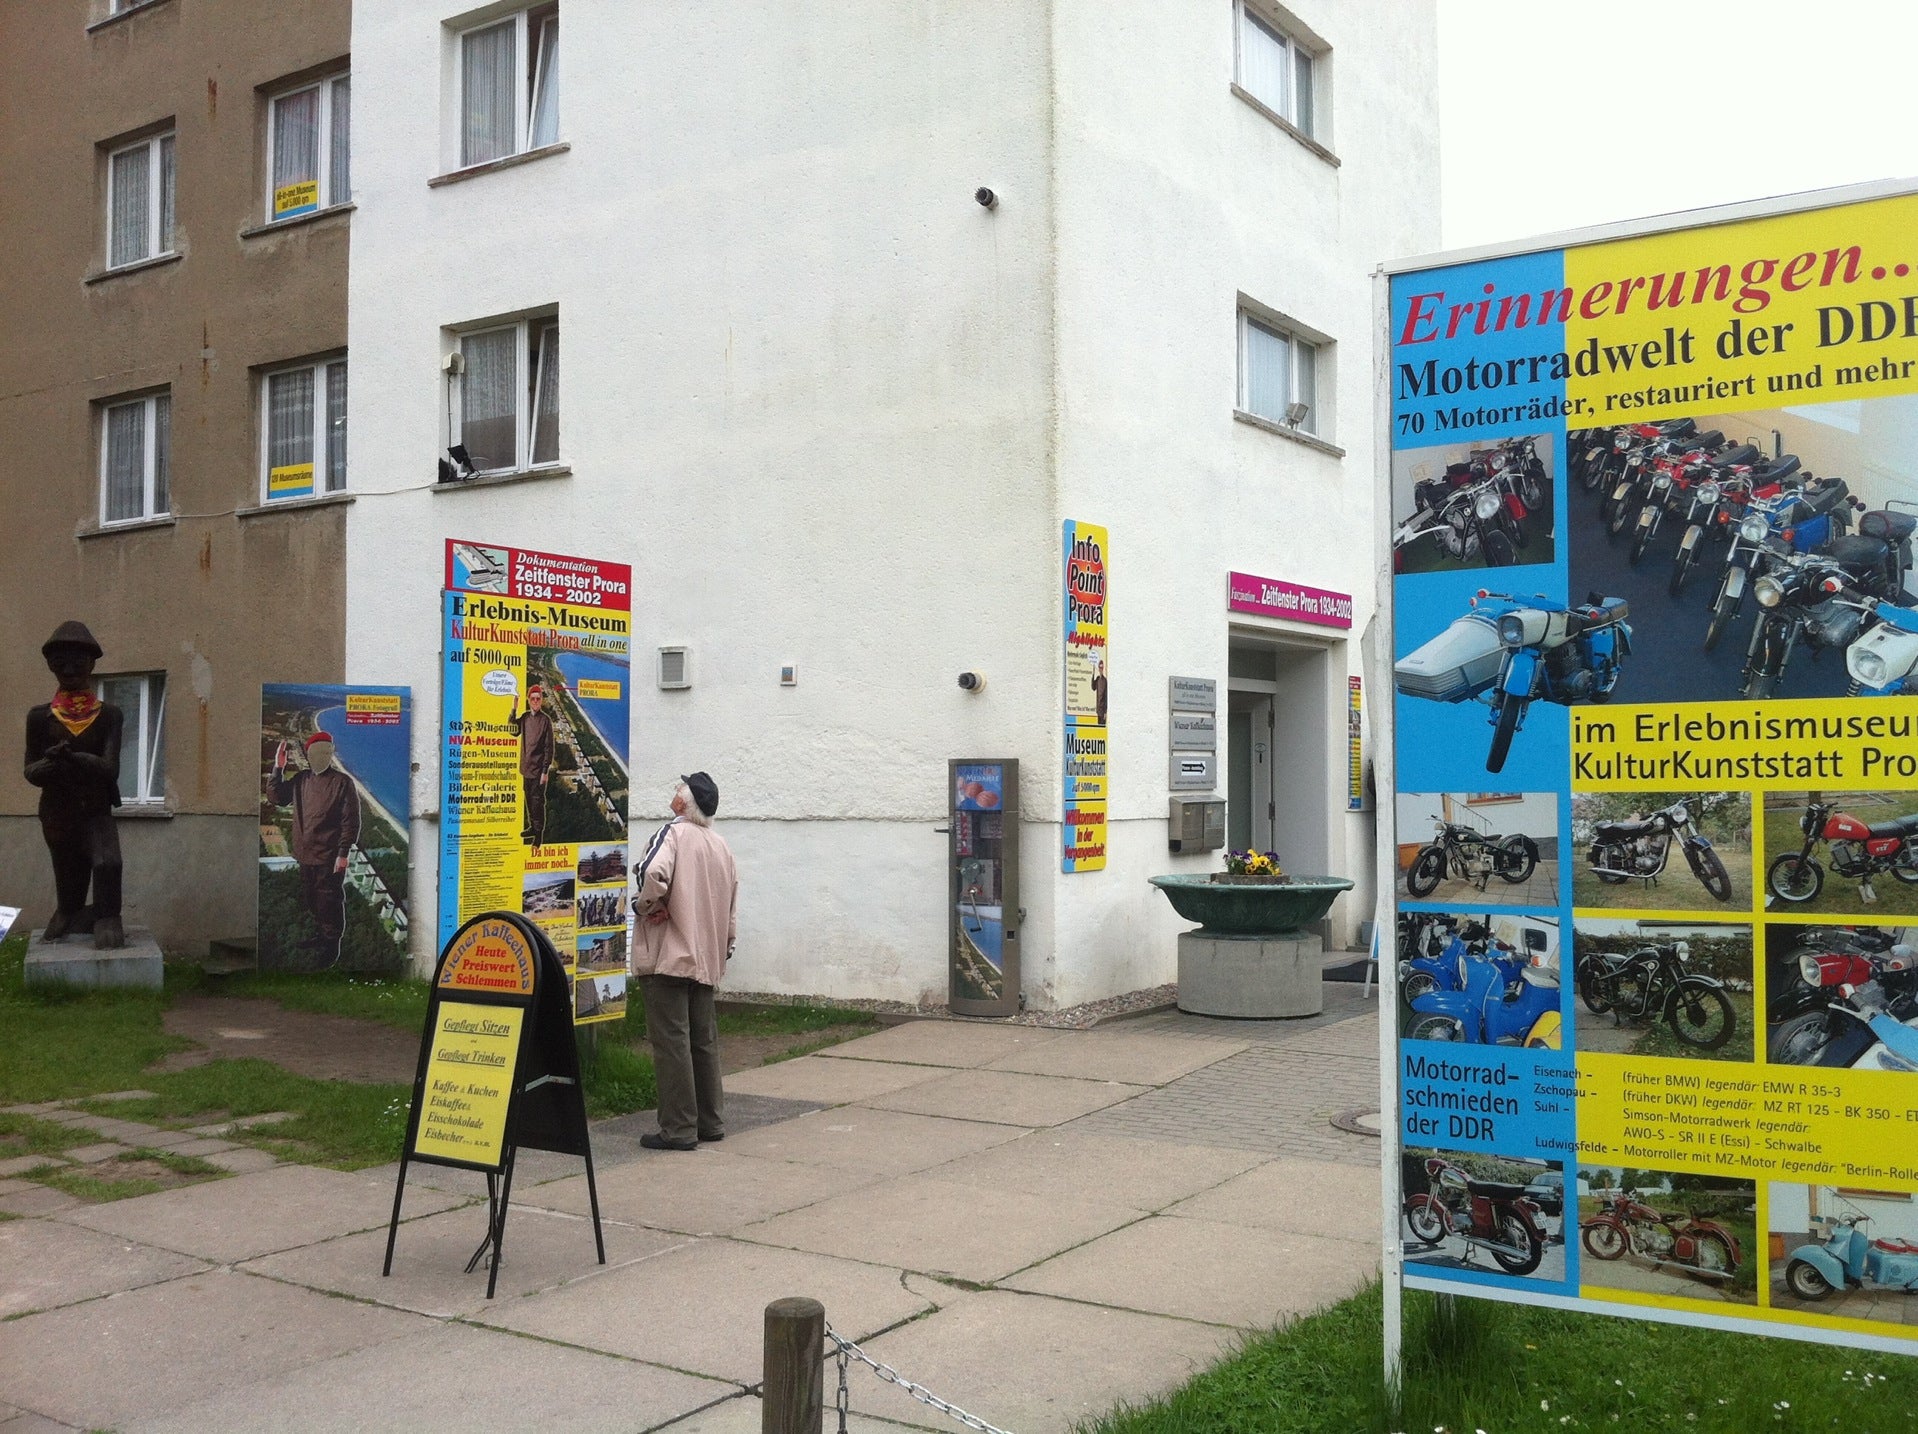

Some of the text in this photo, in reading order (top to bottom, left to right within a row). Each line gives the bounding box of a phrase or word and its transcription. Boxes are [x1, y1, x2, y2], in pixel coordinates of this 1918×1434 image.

[1398, 326, 1696, 401] Motorradwelt
[1716, 319, 1794, 359] der
[1398, 356, 1916, 436] 70 Motorräder, restauriert und mehr
[1072, 533, 1100, 562] Info
[516, 552, 599, 574] Dokumentation
[515, 564, 627, 595] Zeitfenster Prora
[1069, 564, 1103, 595] Point
[515, 582, 552, 599] 1934
[566, 589, 602, 606] 2002
[1261, 583, 1299, 611] Zeitfenster
[1300, 592, 1318, 614] Prora
[1319, 596, 1352, 620] 1934-2002
[452, 596, 627, 633] Erlebnis-Museum
[1069, 595, 1103, 625] Prora
[581, 634, 594, 647] all
[597, 635, 607, 648] in
[609, 639, 627, 650] one
[1068, 631, 1106, 650] Highlights
[450, 648, 522, 671] auf 5000 qm
[449, 735, 518, 746] NVA-Museum
[1574, 716, 1615, 744] im
[449, 748, 517, 759] Rügen-Museum
[1066, 732, 1106, 755] Museum
[448, 760, 517, 770] Sonderausstellungen
[1574, 746, 1917, 781] KulturKunststatt Pro
[449, 783, 517, 792] Bilder-Galerie
[448, 793, 516, 804] Motorradwelt DDR
[448, 805, 475, 815] Wiener
[1065, 809, 1104, 826] Willkommen
[1077, 827, 1093, 842] in der
[531, 846, 568, 857] Da bin ich
[1064, 843, 1105, 862] Vergangenheit
[525, 859, 548, 870] immer
[441, 931, 478, 984] Wiener
[475, 945, 507, 958] Heute
[462, 958, 516, 973] Preiswert
[455, 973, 517, 988] Schlemmen
[443, 1018, 511, 1034] Gepflegt Sitzen
[437, 1048, 506, 1064] Gepflegt Trinken
[1406, 1055, 1519, 1086] Motorrad-
[432, 1080, 459, 1094] Kaffee
[467, 1083, 499, 1098] Kuchen
[1534, 1065, 1581, 1080] Eisenach
[1622, 1071, 1661, 1085] (früher
[1665, 1074, 1701, 1089] BMW)
[1763, 1081, 1794, 1096] EMW
[1799, 1083, 1807, 1096] R
[1812, 1084, 1841, 1098] 35-3
[1406, 1085, 1518, 1116] schmieden
[1534, 1083, 1586, 1098] Zschopau
[1622, 1089, 1661, 1103] (früher
[1665, 1093, 1697, 1107] DKW)
[1764, 1101, 1783, 1112] MZ
[1787, 1102, 1802, 1114] RT
[1807, 1103, 1830, 1116] 125
[1845, 1105, 1861, 1118] BK
[1866, 1107, 1890, 1120] 350
[1534, 1101, 1559, 1112] Suhl
[427, 1112, 484, 1129] Eisschokolade
[1407, 1112, 1495, 1141] der DDR
[1623, 1107, 1751, 1128] Simson-Motorradwerk
[1624, 1126, 1665, 1141] AWO-S
[1678, 1131, 1694, 1143] SR
[1710, 1133, 1716, 1144] E
[1721, 1134, 1750, 1149] (Essi)
[1765, 1138, 1822, 1154] Schwalbe
[1535, 1137, 1608, 1154] Ludwigsfelde
[1624, 1145, 1688, 1161] Motorroller
[1692, 1152, 1711, 1163] mit
[1715, 1153, 1777, 1169] MZ-Motor
